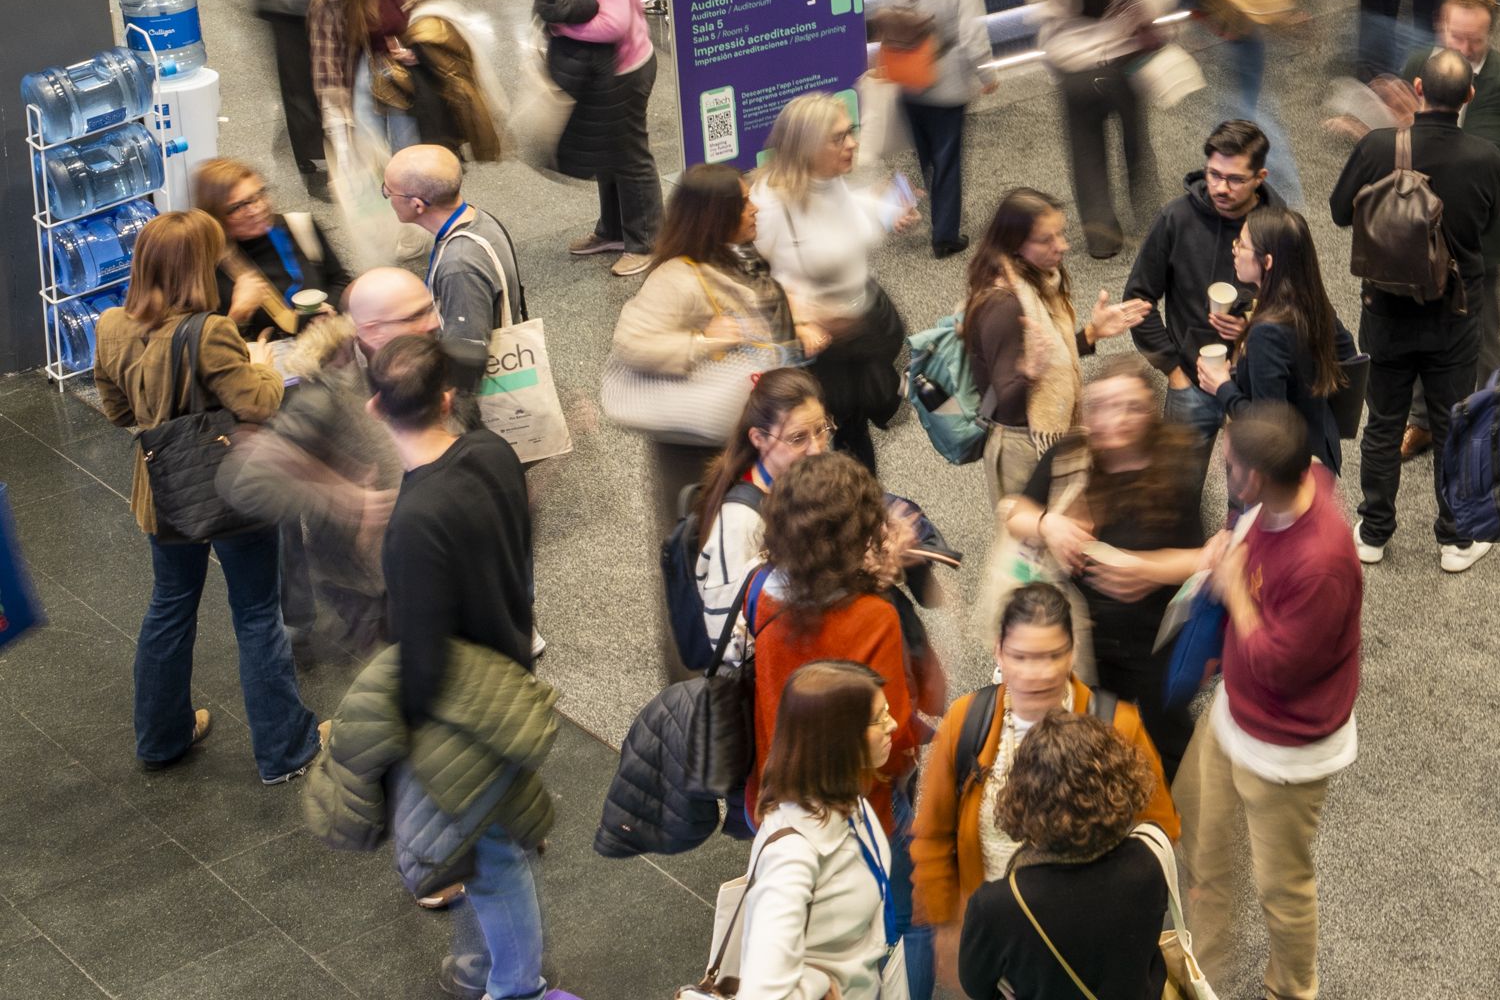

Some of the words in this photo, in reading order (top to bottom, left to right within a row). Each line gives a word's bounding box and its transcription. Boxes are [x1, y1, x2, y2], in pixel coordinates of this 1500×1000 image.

[691, 9, 727, 22] Auditorio
[732, 0, 772, 13] Auditorium
[148, 28, 176, 41] Culligan
[692, 22, 715, 35] Sala
[716, 19, 724, 29] 5
[692, 35, 709, 45] Sala
[722, 28, 743, 38] Room
[744, 25, 750, 33] 5
[694, 37, 746, 57] Impressió
[747, 23, 817, 45] acreditacions
[694, 52, 733, 67] Impresión
[733, 40, 788, 58] acreditaciones
[794, 32, 819, 43] Badges
[820, 26, 847, 39] printing
[741, 86, 776, 99] Descarrega
[777, 82, 792, 90] l'app
[795, 75, 821, 85] consulta
[486, 344, 535, 375] ech
